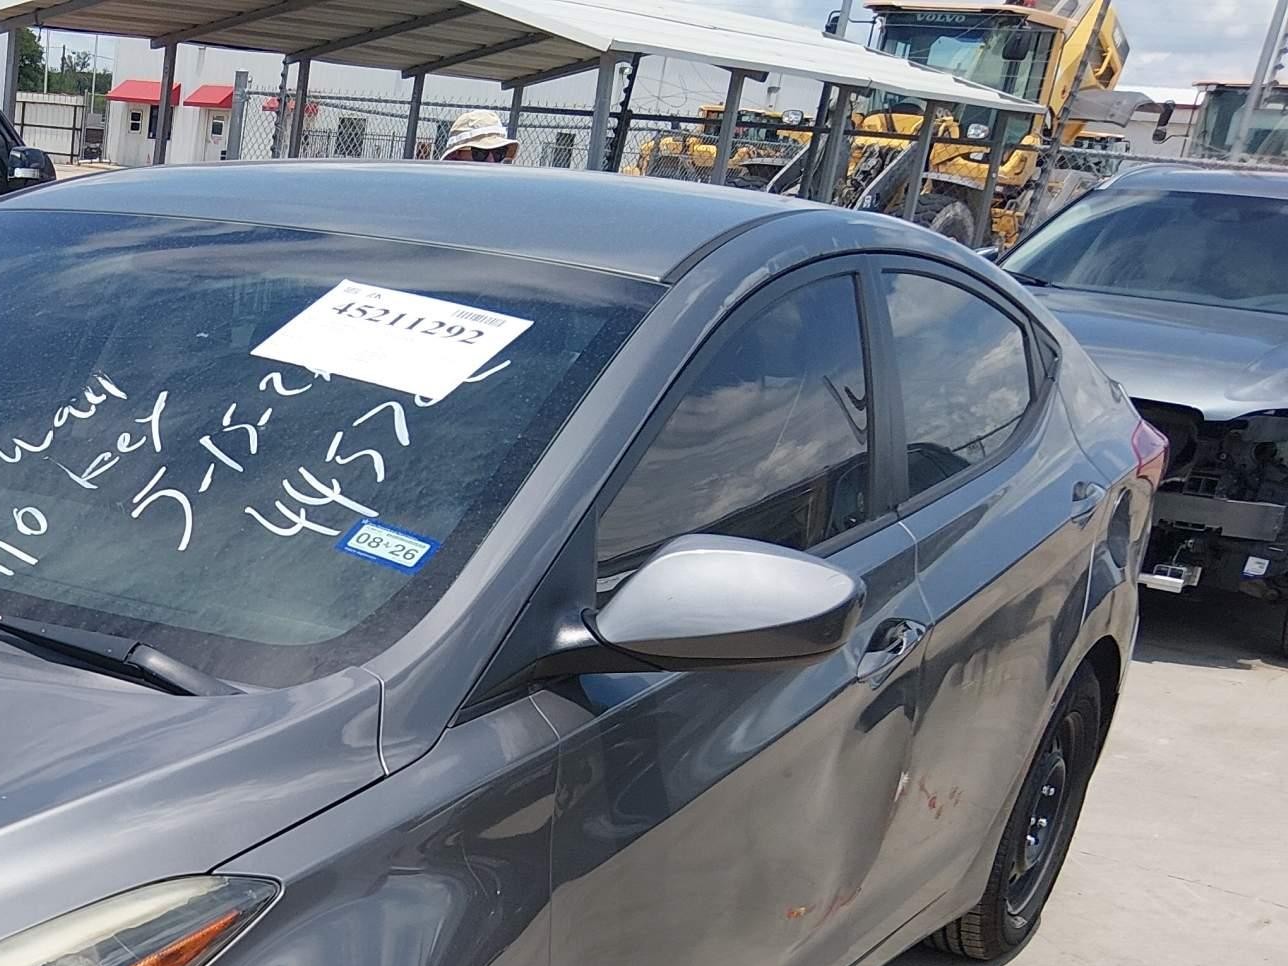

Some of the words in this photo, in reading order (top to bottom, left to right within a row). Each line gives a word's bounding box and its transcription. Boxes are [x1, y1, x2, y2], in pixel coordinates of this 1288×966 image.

[916, 13, 966, 23] VOLVO
[331, 302, 485, 345] 45211292
[130, 369, 331, 551] 5-15-2
